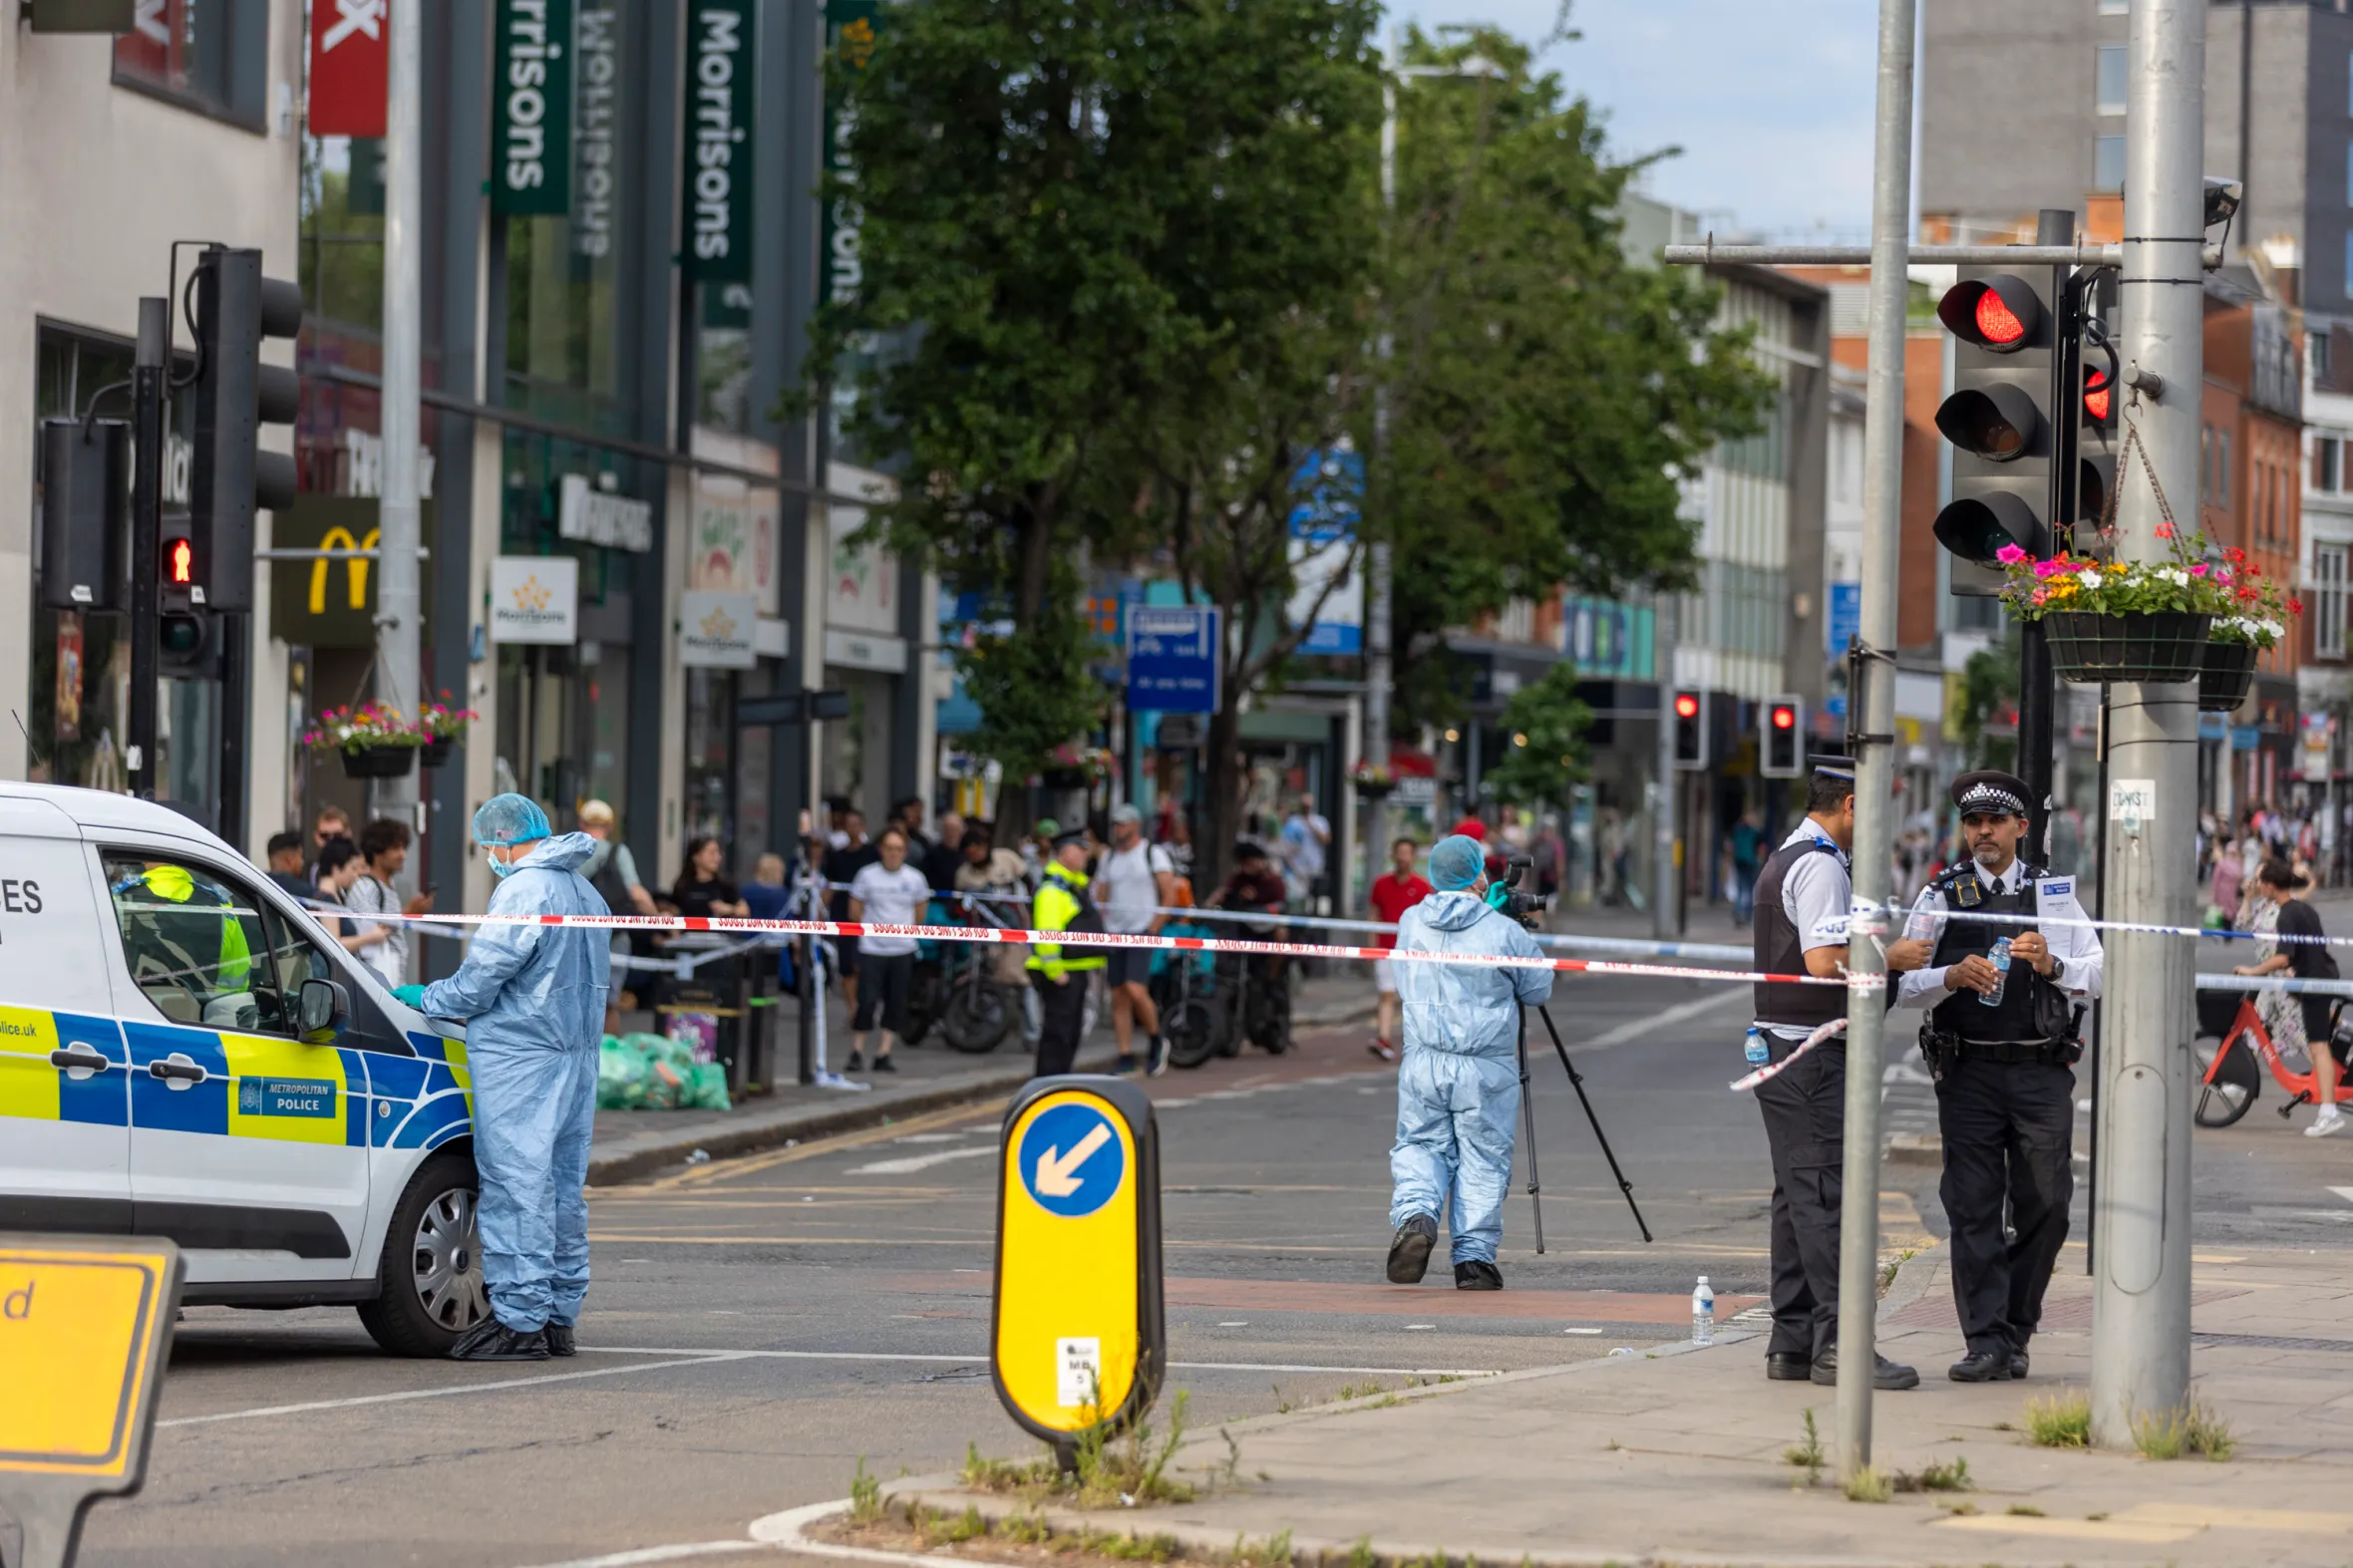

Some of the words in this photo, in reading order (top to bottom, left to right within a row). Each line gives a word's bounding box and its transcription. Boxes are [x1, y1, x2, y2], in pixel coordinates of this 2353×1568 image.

[694, 9, 746, 259] Morrisons
[0, 879, 43, 914] ES
[0, 1021, 37, 1038] lice.uk
[268, 1084, 329, 1096] METROPOLITAN
[276, 1098, 319, 1110] POLICE
